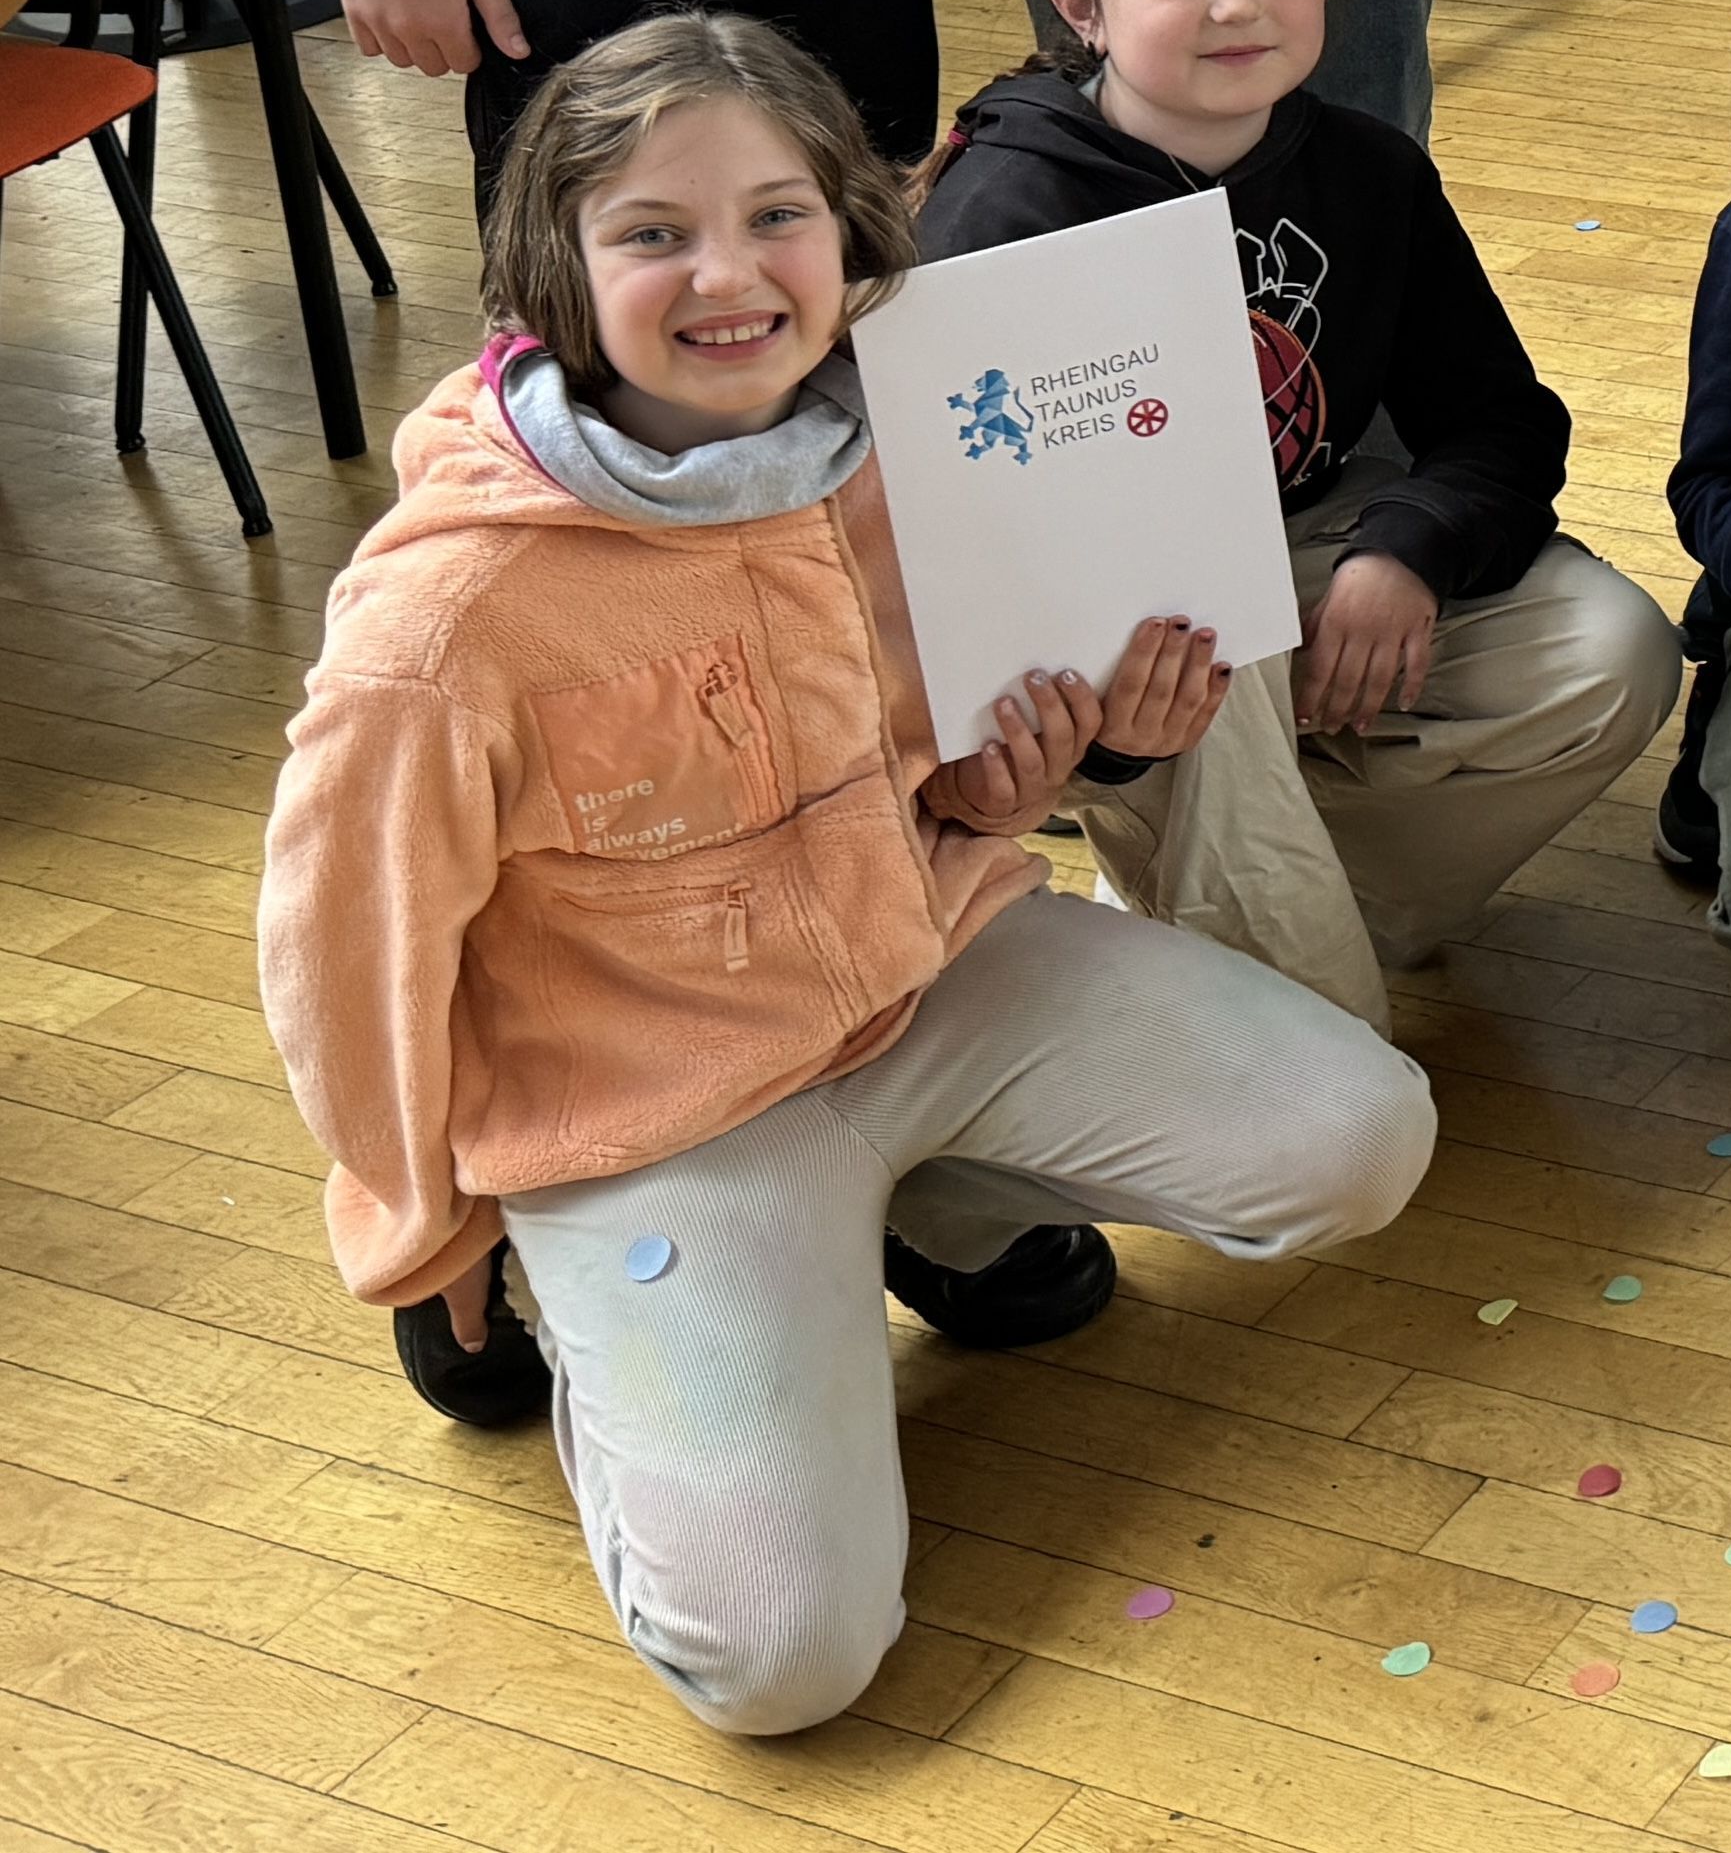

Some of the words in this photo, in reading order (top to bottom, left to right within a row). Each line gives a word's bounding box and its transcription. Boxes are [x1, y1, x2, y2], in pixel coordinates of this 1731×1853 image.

[1030, 343, 1160, 396] RHEINGAU
[1034, 378, 1138, 423] TAUNUS
[1042, 413, 1116, 449] KREIS
[574, 779, 655, 813] there
[582, 815, 608, 834] is
[585, 817, 687, 853] always
